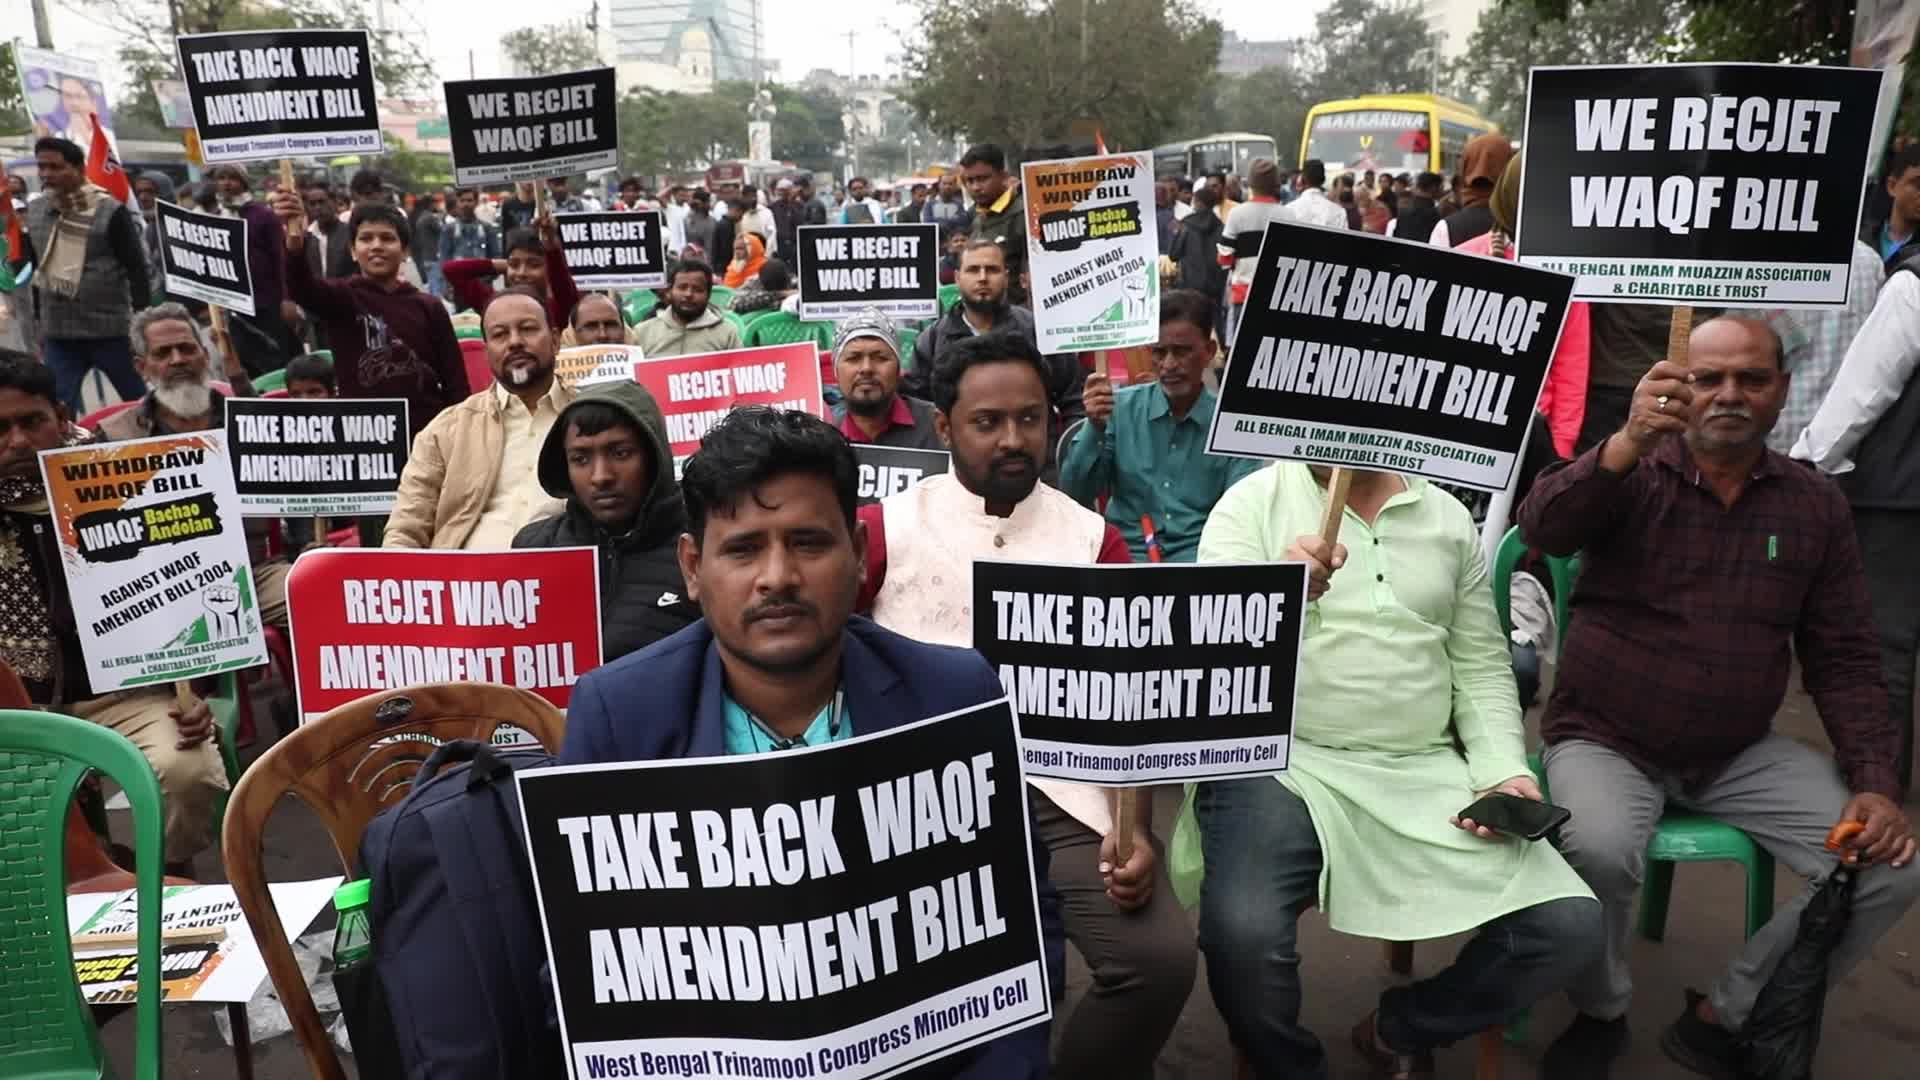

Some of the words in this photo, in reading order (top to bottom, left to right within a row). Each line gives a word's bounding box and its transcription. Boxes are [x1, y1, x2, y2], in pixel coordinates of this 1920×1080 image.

[191, 51, 240, 83] TAKE
[240, 47, 297, 79] BACK
[301, 46, 360, 79] WAQF
[204, 90, 319, 125] AMENDMENT
[322, 88, 365, 118] BILL
[468, 93, 510, 119] WE
[514, 83, 596, 117] RECJET
[473, 125, 544, 153] WAQF
[550, 118, 597, 146] BILL
[1574, 98, 1659, 152] WE
[1669, 96, 1840, 154] RECJET
[1036, 166, 1135, 187] WITHDRAW
[1042, 189, 1092, 205] WAQF
[1097, 185, 1131, 200] BILL
[1570, 175, 1725, 235] WAQF
[1731, 177, 1820, 233] BILL
[164, 215, 184, 240] WE
[182, 221, 230, 252] RECJET
[560, 223, 589, 242] WE
[590, 221, 646, 241] RECJET
[1043, 216, 1087, 242] WAQF
[1088, 208, 1127, 223] Bachao
[1089, 219, 1136, 238] Andolan
[170, 245, 205, 276] WAQF
[206, 255, 239, 282] BILL
[564, 247, 612, 267] WAQF
[615, 246, 649, 265] BILL
[815, 238, 848, 261] WE
[851, 236, 920, 259] RECJET
[817, 268, 876, 292] WAQF
[880, 267, 920, 289] BILL
[1043, 278, 1095, 309] AMENDENT
[1096, 269, 1117, 286] BILL
[1118, 256, 1146, 276] 2004
[1051, 261, 1094, 288] AGAINST
[1094, 247, 1124, 268] WAQF
[1568, 263, 1627, 277] BENGAL
[1630, 265, 1674, 278] IMAM
[1678, 265, 1743, 280] MUAZZIN
[1745, 268, 1831, 282] ASSOCIATION
[1268, 256, 1347, 318] TAKE
[1343, 268, 1437, 332] BACK
[1441, 283, 1547, 355] WAQF
[1613, 282, 1623, 293] &
[1627, 282, 1720, 297] CHARITABLE
[1724, 285, 1767, 298] TRUST
[556, 353, 629, 368] ITHDRAW
[597, 367, 625, 377] BILL
[668, 371, 732, 402] RECJET
[733, 362, 786, 394] WAQF
[1246, 336, 1446, 410] AMENDMENT
[1440, 363, 1516, 426] BILL
[235, 415, 281, 443] TAKE
[283, 415, 336, 444] BACK
[341, 415, 397, 444] WAQF
[1234, 419, 1259, 434] ALL
[1260, 422, 1308, 440] BENGAL
[1309, 427, 1347, 444] IMAM
[1348, 430, 1403, 450] MUAZZIN
[1403, 437, 1496, 467] ASSOCIATION
[62, 450, 204, 481] WITHDRAW
[240, 454, 354, 482] AMENDMENT
[358, 453, 397, 480] BILL
[1293, 444, 1303, 456] &
[1305, 444, 1379, 466] CHARITABLE
[1380, 451, 1426, 470] TRUST
[75, 480, 147, 503] WAQF
[153, 473, 203, 493] BILL
[857, 464, 923, 498] CJET
[80, 517, 146, 551] WAQF
[144, 502, 200, 525] Bachao
[149, 517, 214, 542] Andolan
[101, 571, 160, 608] AGAINST
[160, 551, 201, 580] WAQF
[92, 594, 167, 637] AMENDENT
[164, 578, 196, 602] BILL
[195, 560, 233, 587] 2004
[343, 579, 445, 625] RECJET
[449, 579, 540, 629] WAQF
[992, 590, 1074, 646] TAKE
[1081, 595, 1175, 648] BACK
[1189, 592, 1285, 648] WAQF
[319, 643, 505, 690] AMENDMENT
[512, 641, 580, 690] BILL
[1208, 666, 1272, 717] BILL
[492, 732, 521, 744] UST
[1066, 749, 1134, 771] Trinamool
[1136, 750, 1197, 771] Congress
[1199, 745, 1250, 769] Minority
[1253, 742, 1278, 763] Cell
[557, 811, 690, 893] TAKE
[691, 794, 846, 889] BACK
[857, 751, 997, 865] WAQF
[589, 896, 899, 1005] AMENDMENT
[909, 864, 1007, 965] BILL
[585, 1053, 639, 1080] West
[641, 1051, 711, 1080] Bengal
[712, 1050, 815, 1080] Trinamool
[818, 1024, 912, 1075] Congress
[913, 996, 991, 1042] Minority
[993, 977, 1029, 1012] Cell
